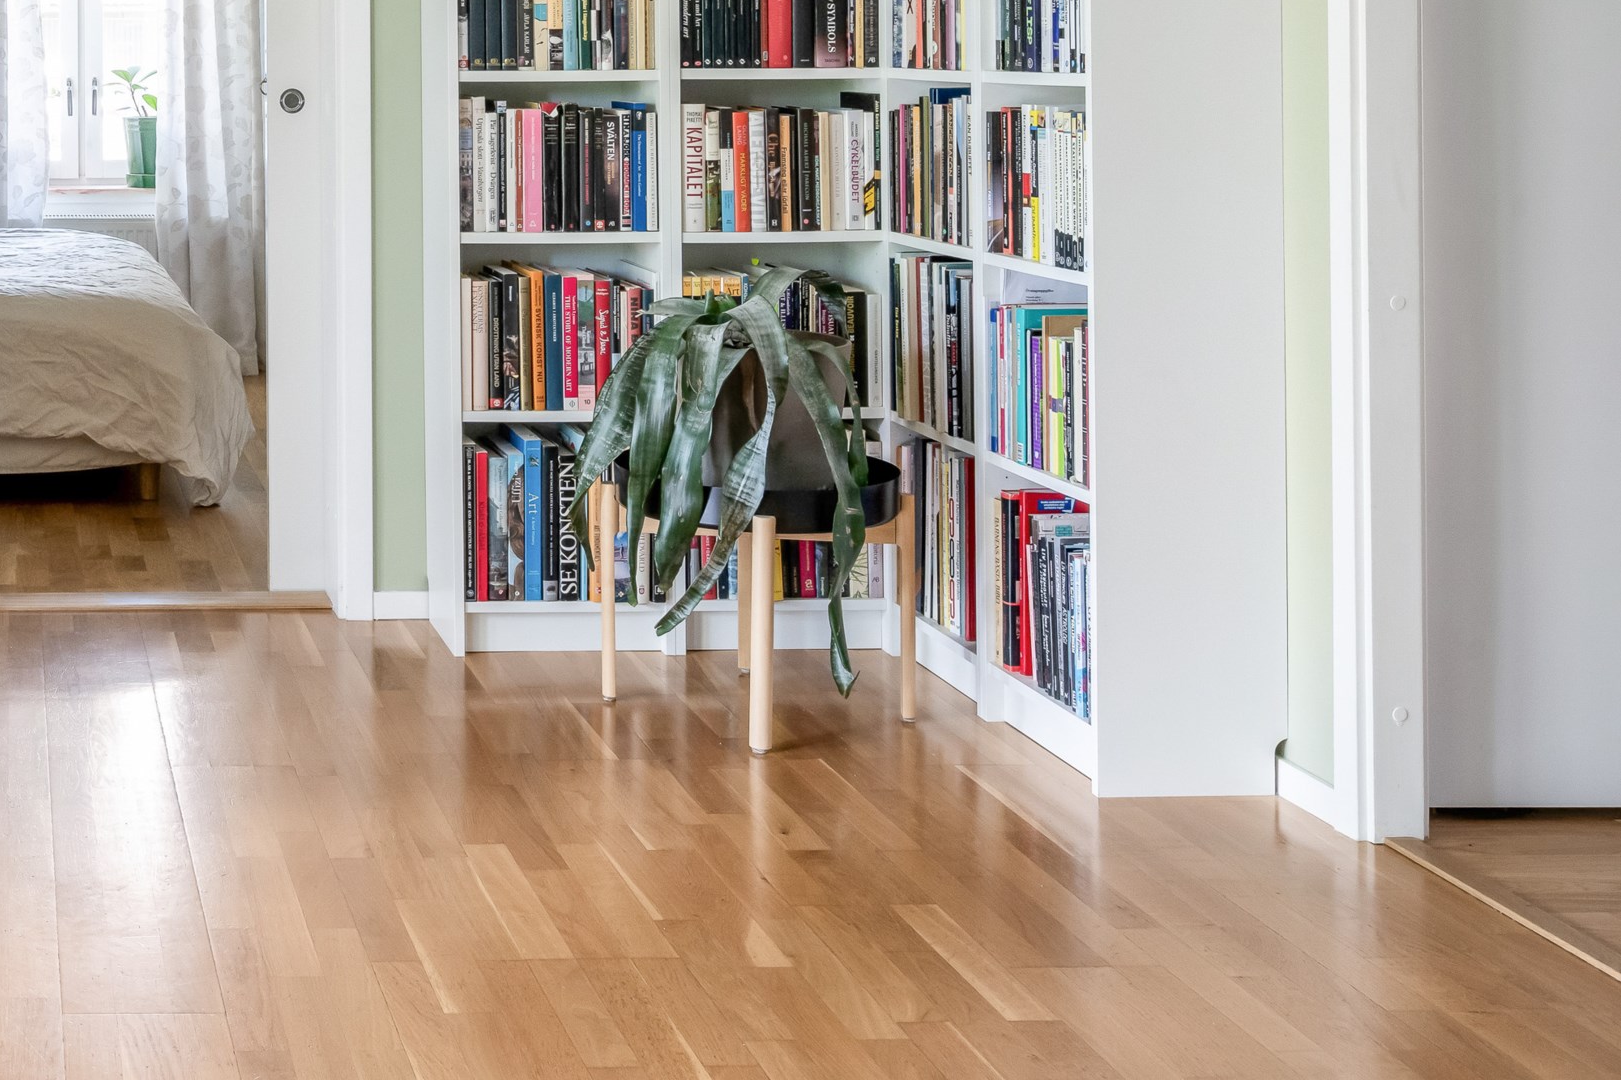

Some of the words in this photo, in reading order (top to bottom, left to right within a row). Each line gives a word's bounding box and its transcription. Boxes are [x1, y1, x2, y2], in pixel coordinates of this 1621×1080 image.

[682, 0, 690, 25] modern
[827, 3, 836, 53] SYMBOLS
[476, 117, 484, 144] Uppsala
[607, 121, 617, 160] SVÄLTEN
[488, 132, 496, 166] Lagerkvist
[767, 133, 779, 157] Che
[686, 127, 703, 199] KAPITALET
[851, 139, 859, 203] CYKELBUDET
[476, 166, 484, 203] Vasaborgen
[488, 172, 497, 200] Dvärgen
[595, 309, 610, 328] Sigrid
[630, 297, 639, 330] NINA
[565, 335, 572, 344] OF
[536, 371, 543, 383] NU
[511, 477, 522, 504] Uffizi
[527, 492, 539, 515] Art
[559, 462, 578, 563] KONSTEN
[560, 570, 577, 594] SE
